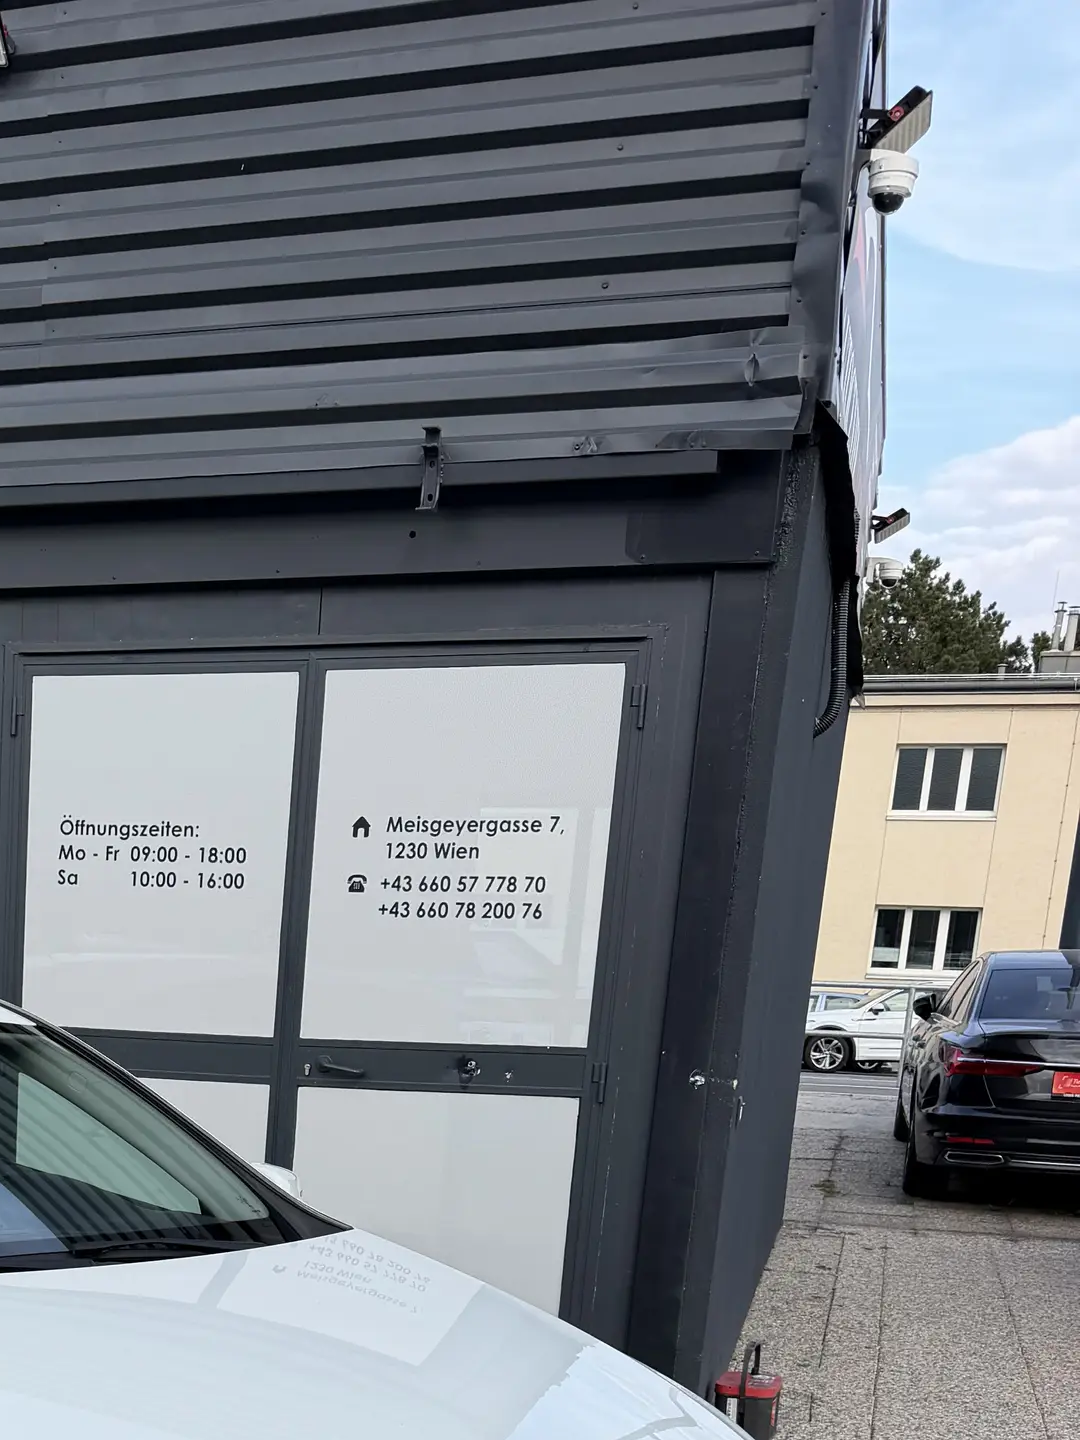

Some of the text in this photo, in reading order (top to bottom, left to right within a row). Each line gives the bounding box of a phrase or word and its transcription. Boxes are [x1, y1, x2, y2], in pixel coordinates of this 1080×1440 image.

[59, 814, 200, 841] Öffnungszeiten:
[385, 815, 565, 837] Meisgeyergasse 7,
[58, 844, 86, 861] Mo
[105, 845, 121, 861] Fr
[130, 845, 178, 863] 09:00
[198, 847, 247, 864] 18:00
[385, 842, 480, 860] 1230 Wien
[57, 869, 78, 886] Sa
[130, 871, 177, 888] 10:00
[197, 872, 245, 889] 16:00
[380, 875, 546, 893] +43 660 57 778 70
[378, 901, 543, 920] +43 660 78 200 76
